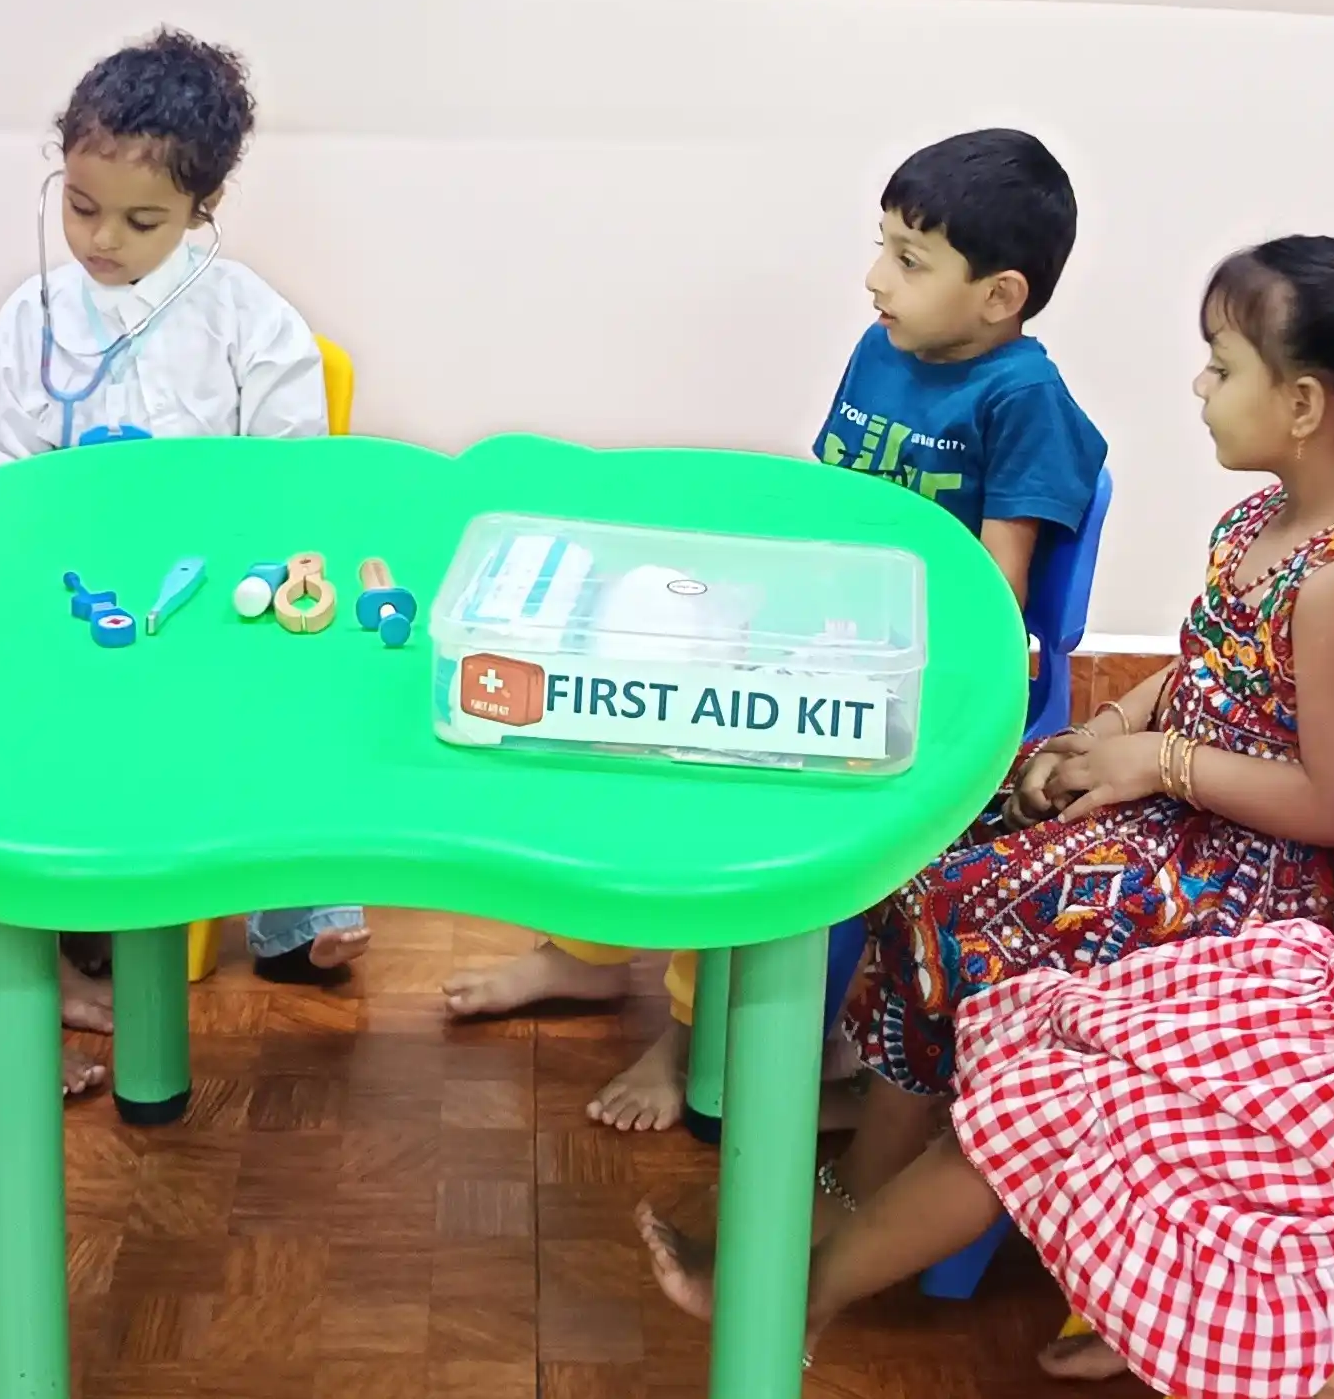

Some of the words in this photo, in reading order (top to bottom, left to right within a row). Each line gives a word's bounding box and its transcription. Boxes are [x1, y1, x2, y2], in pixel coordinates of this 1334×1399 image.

[936, 438, 967, 451] CITY
[545, 673, 679, 723] FIRST
[690, 686, 780, 731] AID
[796, 697, 875, 740] KIT
